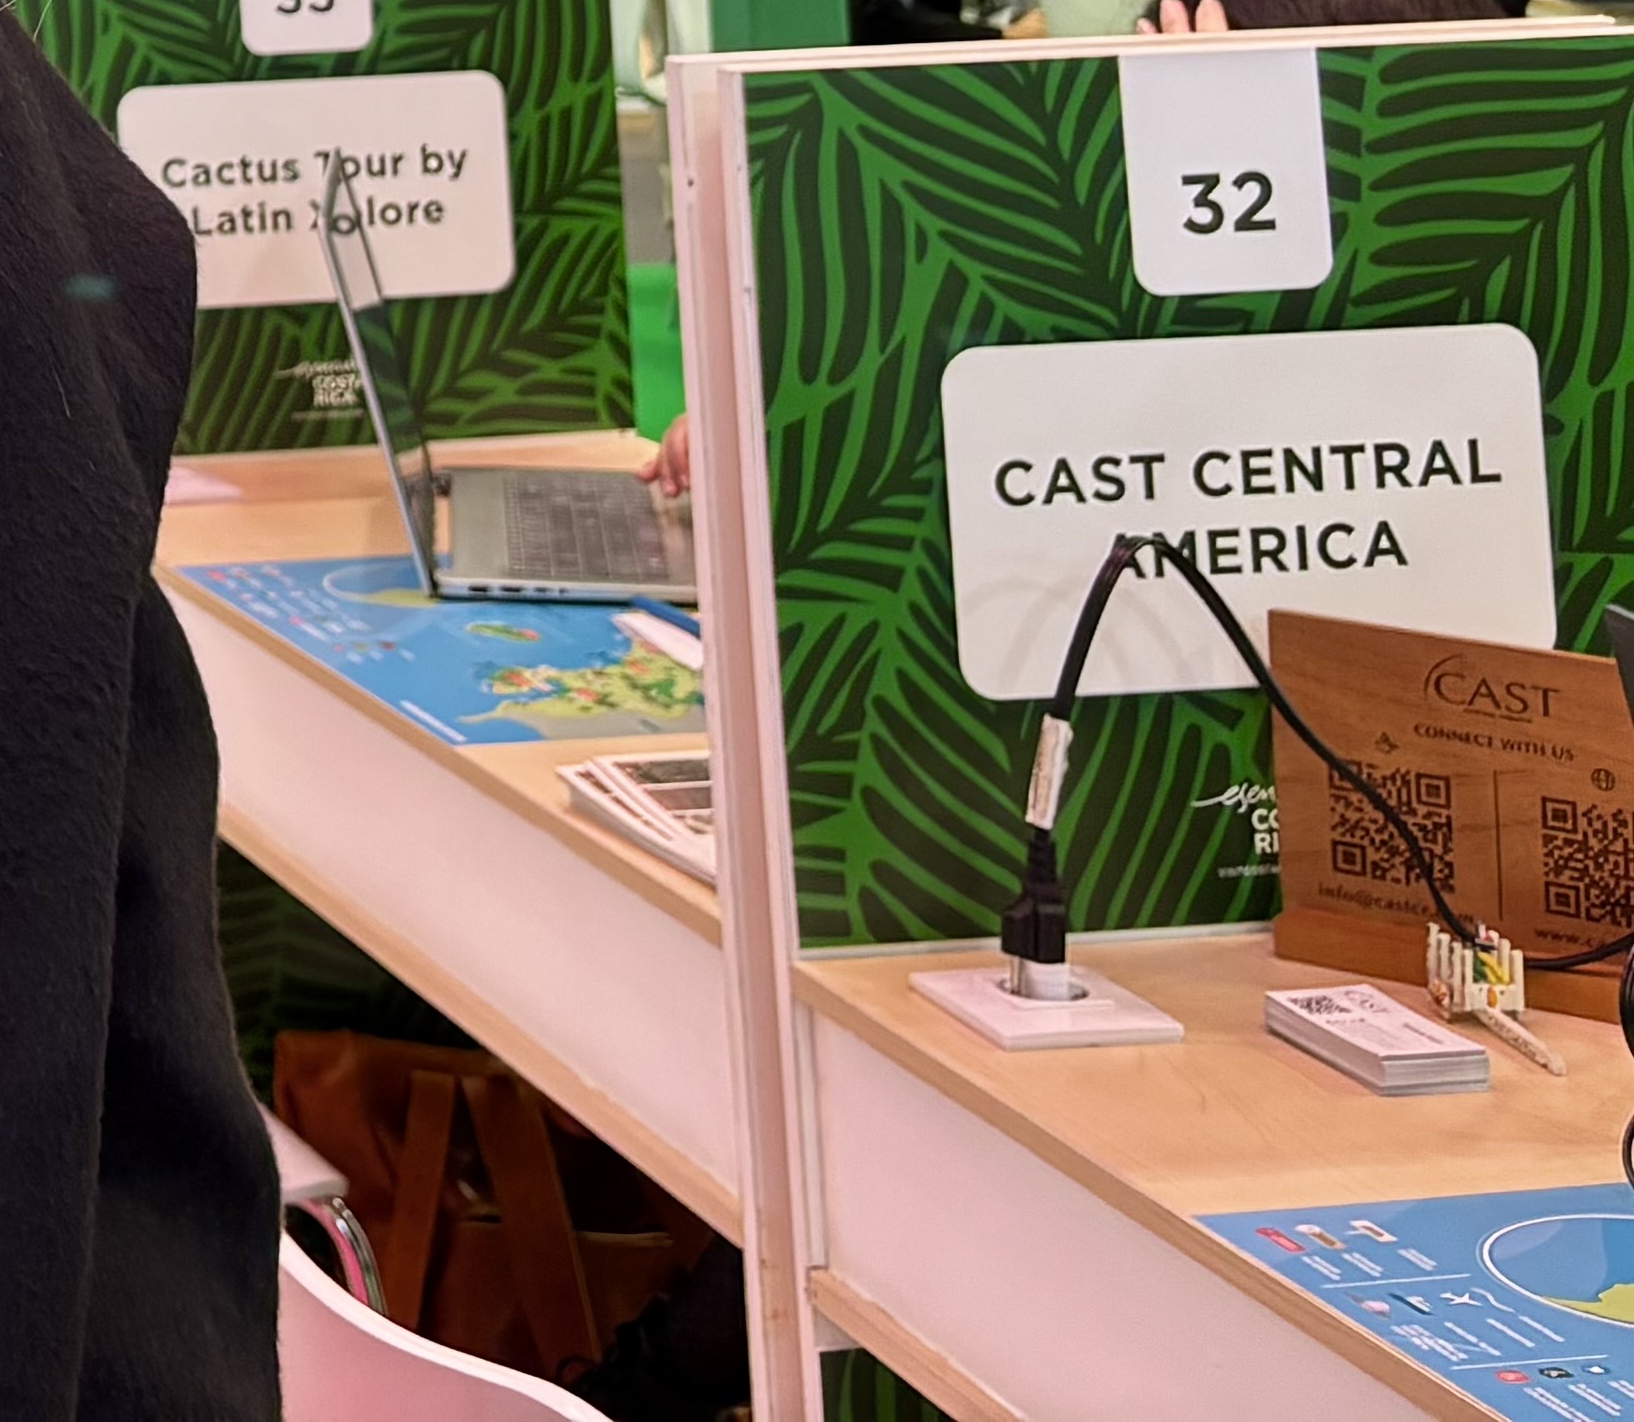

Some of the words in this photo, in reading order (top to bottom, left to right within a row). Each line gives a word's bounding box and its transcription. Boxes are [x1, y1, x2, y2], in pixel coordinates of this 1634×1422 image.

[162, 154, 301, 188] Cactus
[421, 143, 468, 182] by
[192, 201, 293, 236] Latin
[1180, 170, 1277, 235] 32
[994, 452, 1166, 508] CAST
[1192, 437, 1503, 498] CENTRAL
[1433, 671, 1562, 719] CAST
[1413, 721, 1494, 750] CONNECT
[1499, 737, 1548, 759] WITH
[1551, 745, 1576, 762] US
[1190, 781, 1277, 815] esen
[1253, 830, 1280, 856] RI
